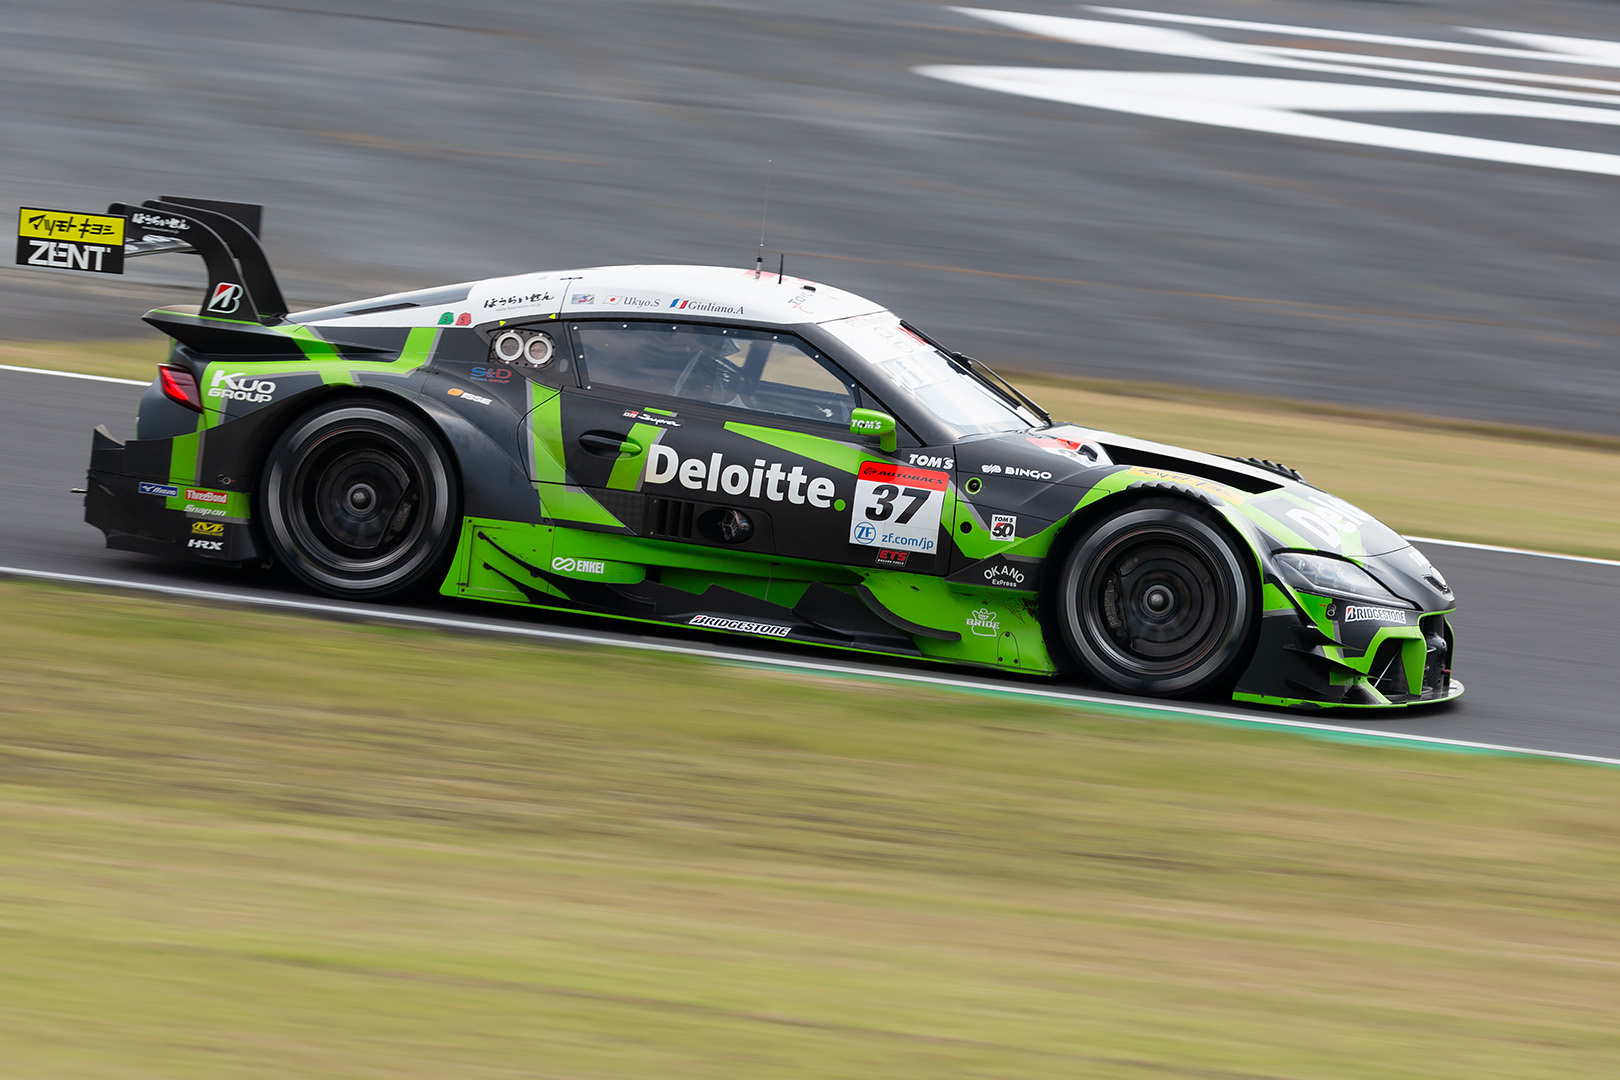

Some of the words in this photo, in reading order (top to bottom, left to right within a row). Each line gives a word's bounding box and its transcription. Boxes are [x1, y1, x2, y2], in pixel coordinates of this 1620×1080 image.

[28, 214, 115, 239] マツモトキヨシ
[28, 240, 103, 271] ZENT
[484, 292, 554, 308] ほうらいせん
[624, 297, 660, 308] Ukyo.S
[688, 301, 744, 314] Giuliano.A
[460, 316, 466, 324] 5
[471, 366, 512, 379] S&D
[208, 388, 273, 403] GROUP
[638, 413, 681, 426] Supra
[851, 419, 882, 430] TOM'S
[909, 453, 955, 470] TOM'S
[878, 470, 943, 485] AUTOBACS
[1004, 466, 1053, 481] BINGO
[186, 489, 228, 504] ThreeBond
[183, 504, 227, 517] Snap-on
[865, 484, 932, 525] 37
[856, 524, 875, 541] ZF
[881, 533, 934, 550] zf.com/jp
[992, 522, 1014, 538] 50
[187, 539, 224, 551] HRX
[880, 550, 907, 561] ETS
[577, 560, 605, 574] ENKEI
[984, 565, 1025, 584] OKANO
[1345, 606, 1406, 623] BRIDGESTONE
[690, 615, 791, 637] BRIDGESTONE
[966, 617, 1000, 631] BRIDE
